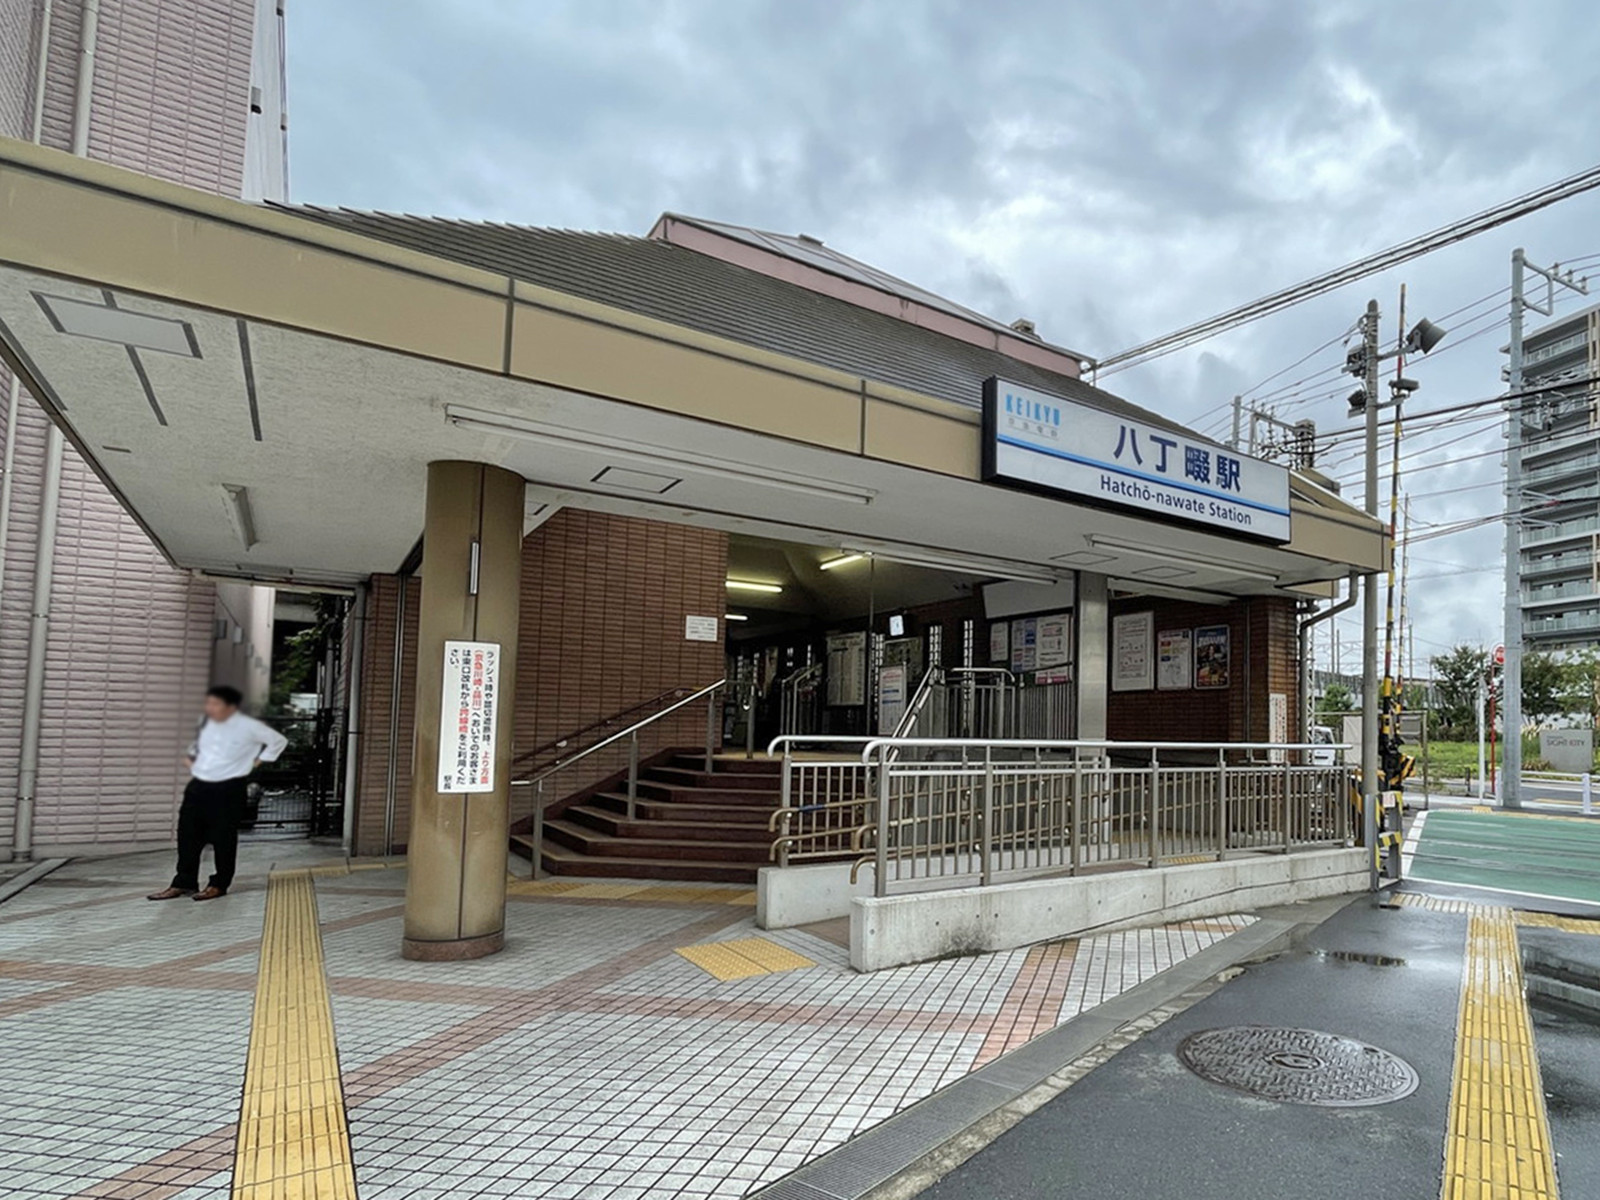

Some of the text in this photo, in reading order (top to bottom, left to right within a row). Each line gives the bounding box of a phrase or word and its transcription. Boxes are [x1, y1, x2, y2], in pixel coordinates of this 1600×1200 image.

[1006, 393, 1060, 426] KEIKYU
[1113, 424, 1241, 492] 八丁畷駅
[1100, 474, 1252, 526] Hatchō-nawate Station
